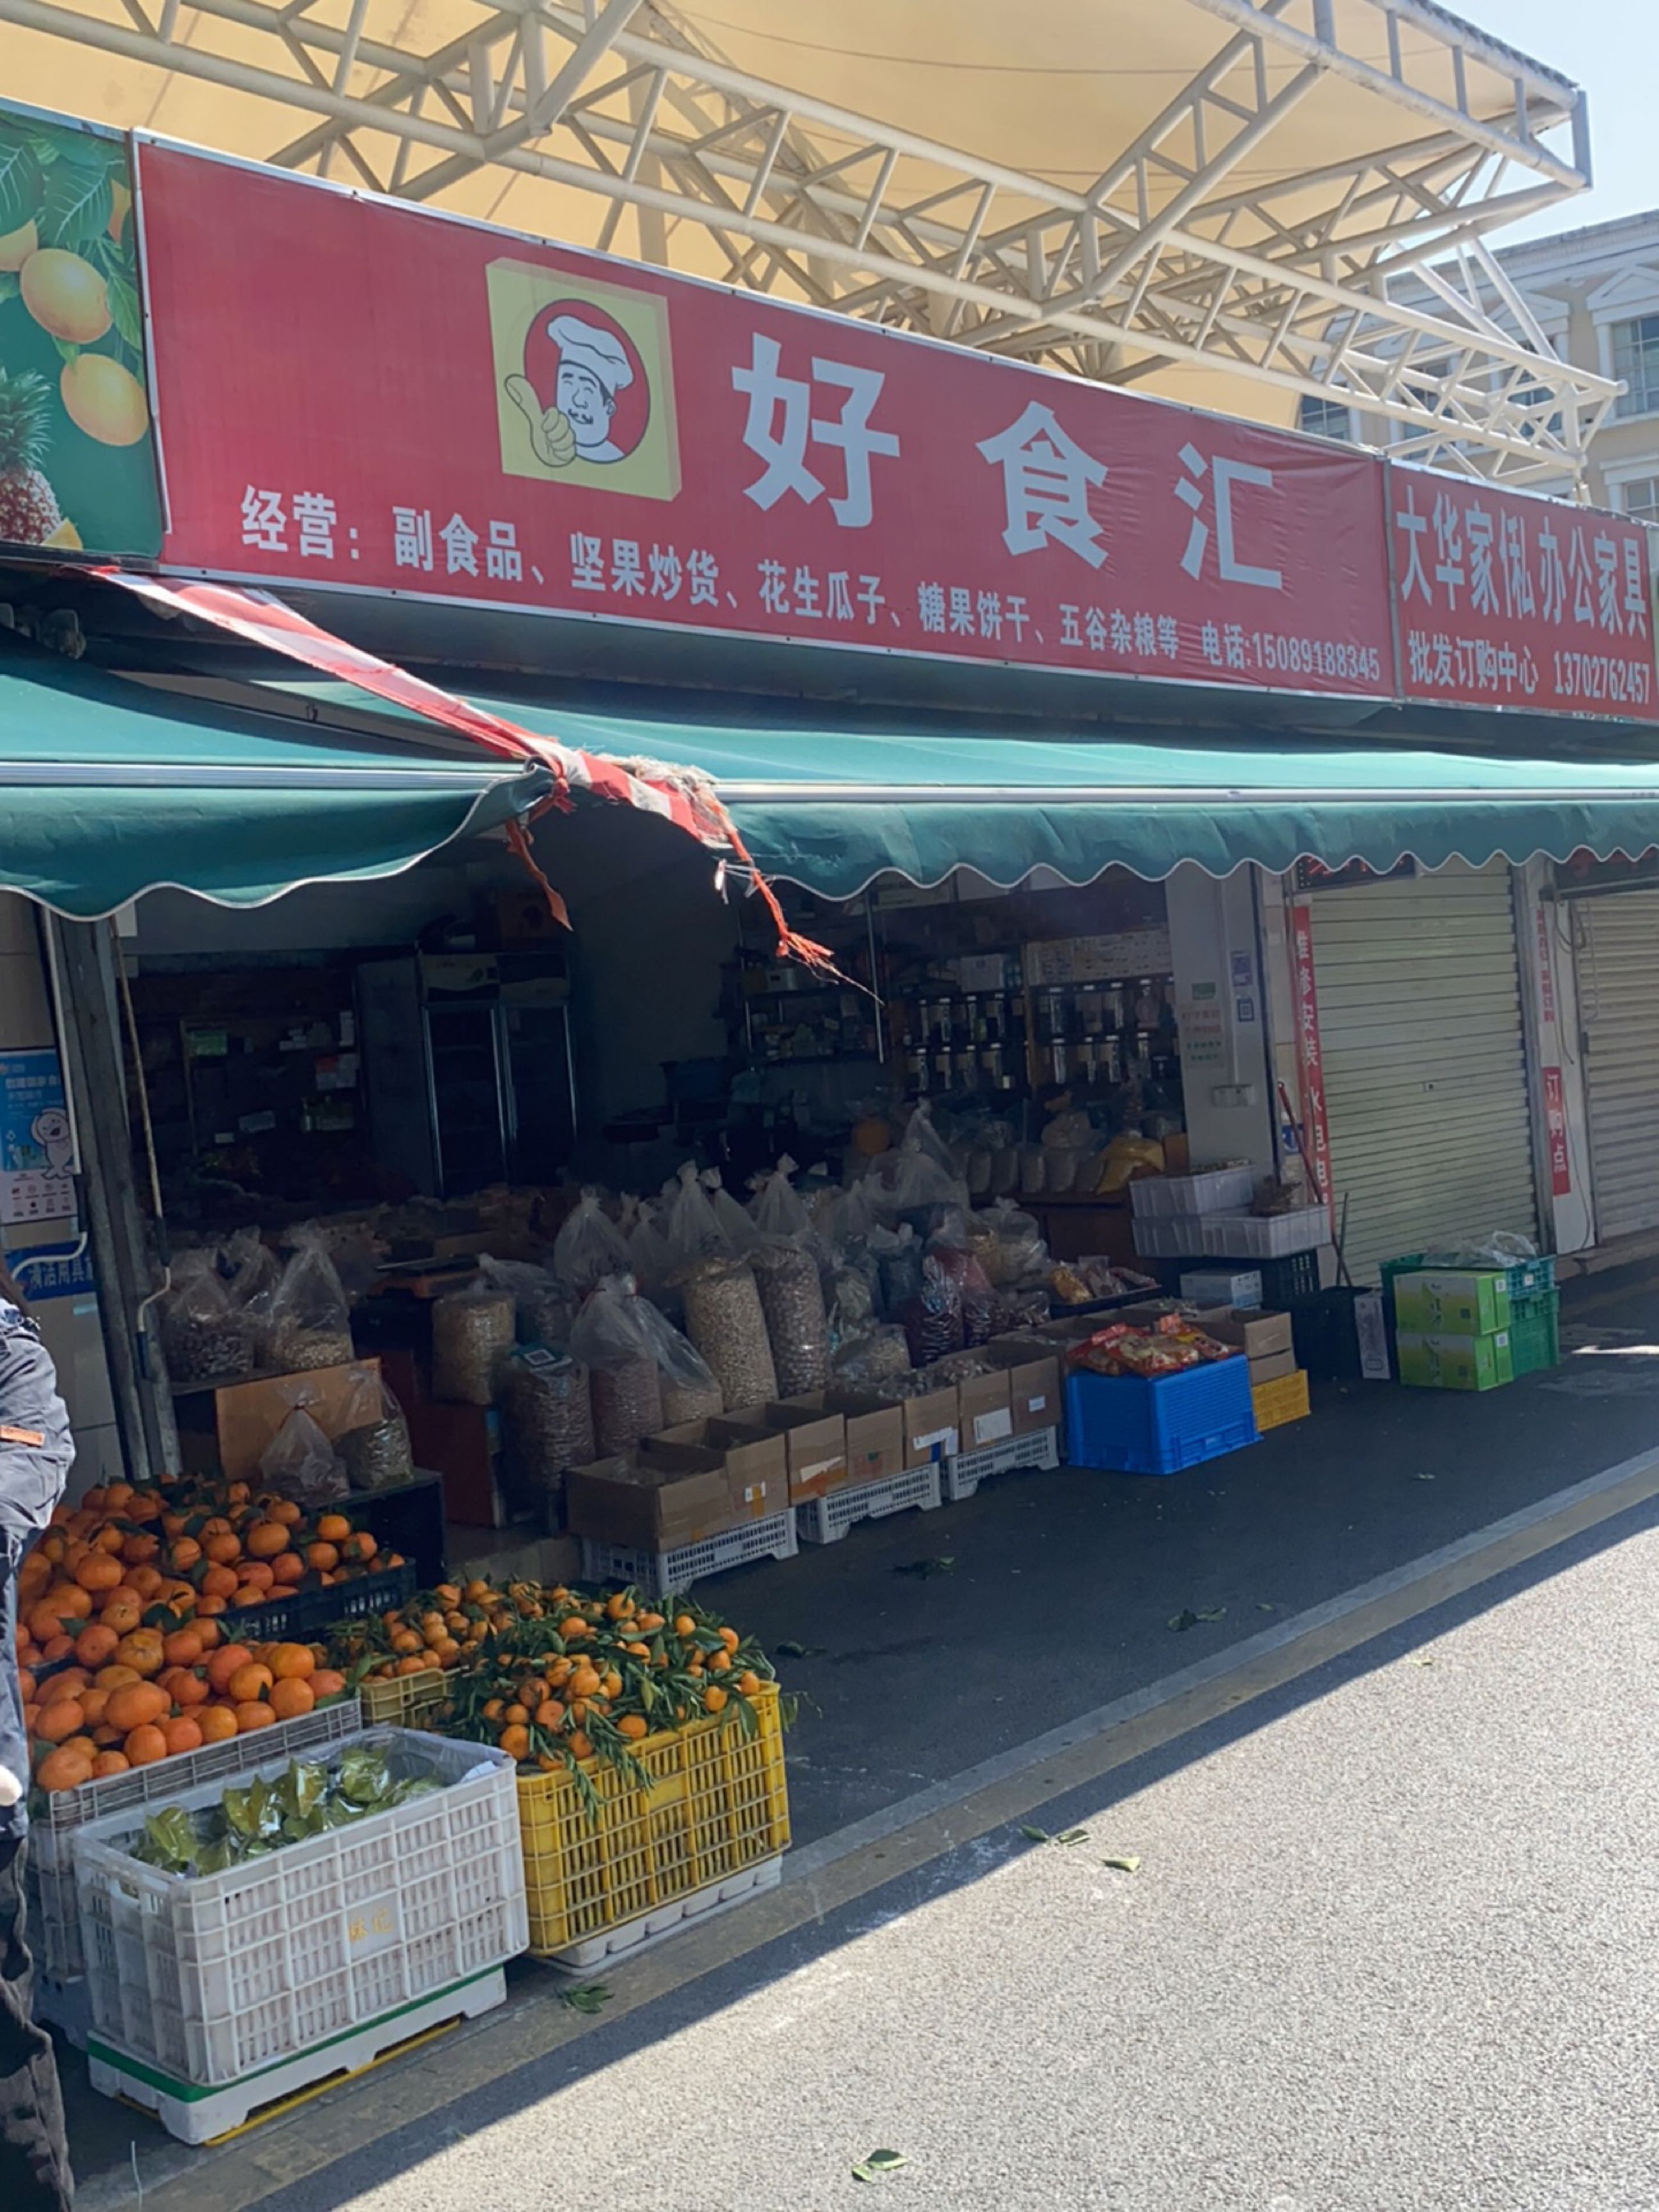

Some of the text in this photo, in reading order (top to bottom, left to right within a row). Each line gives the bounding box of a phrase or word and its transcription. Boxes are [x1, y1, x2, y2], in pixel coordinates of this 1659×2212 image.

[731, 332, 1283, 591] 好食汇
[1407, 630, 1651, 705] 批发订购中心 13702762457
[1546, 1073, 1567, 1173] 订购点
